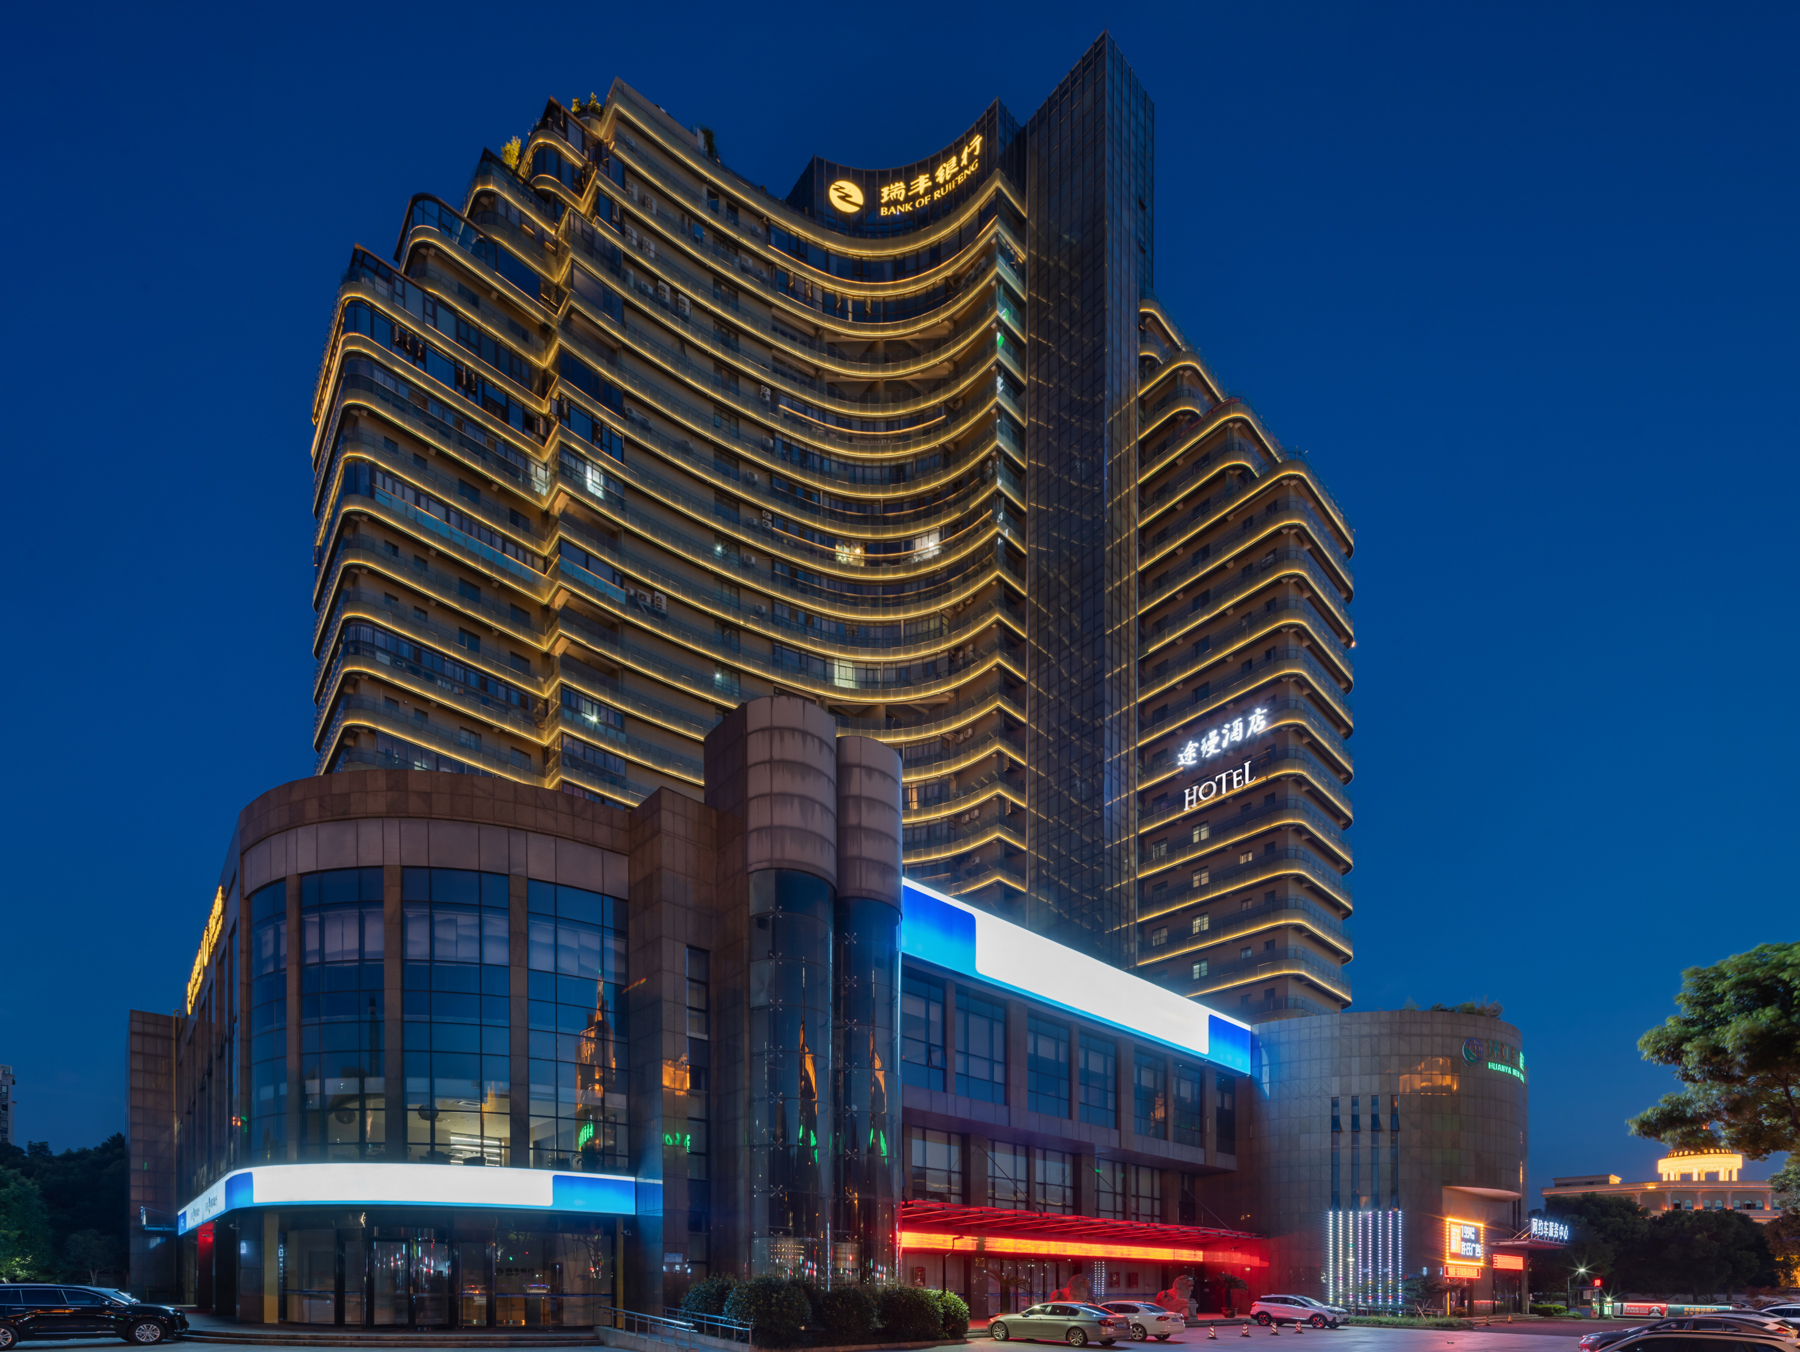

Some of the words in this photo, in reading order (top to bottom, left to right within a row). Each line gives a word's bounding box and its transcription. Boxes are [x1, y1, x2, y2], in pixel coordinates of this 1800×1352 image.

[880, 134, 982, 203] 瑞丰银行
[880, 201, 914, 217] BANK
[915, 195, 932, 208] OF
[933, 158, 980, 201] RUIFENG
[1183, 760, 1257, 812] HOTEL
[1532, 1217, 1569, 1240] 网约车服务中心
